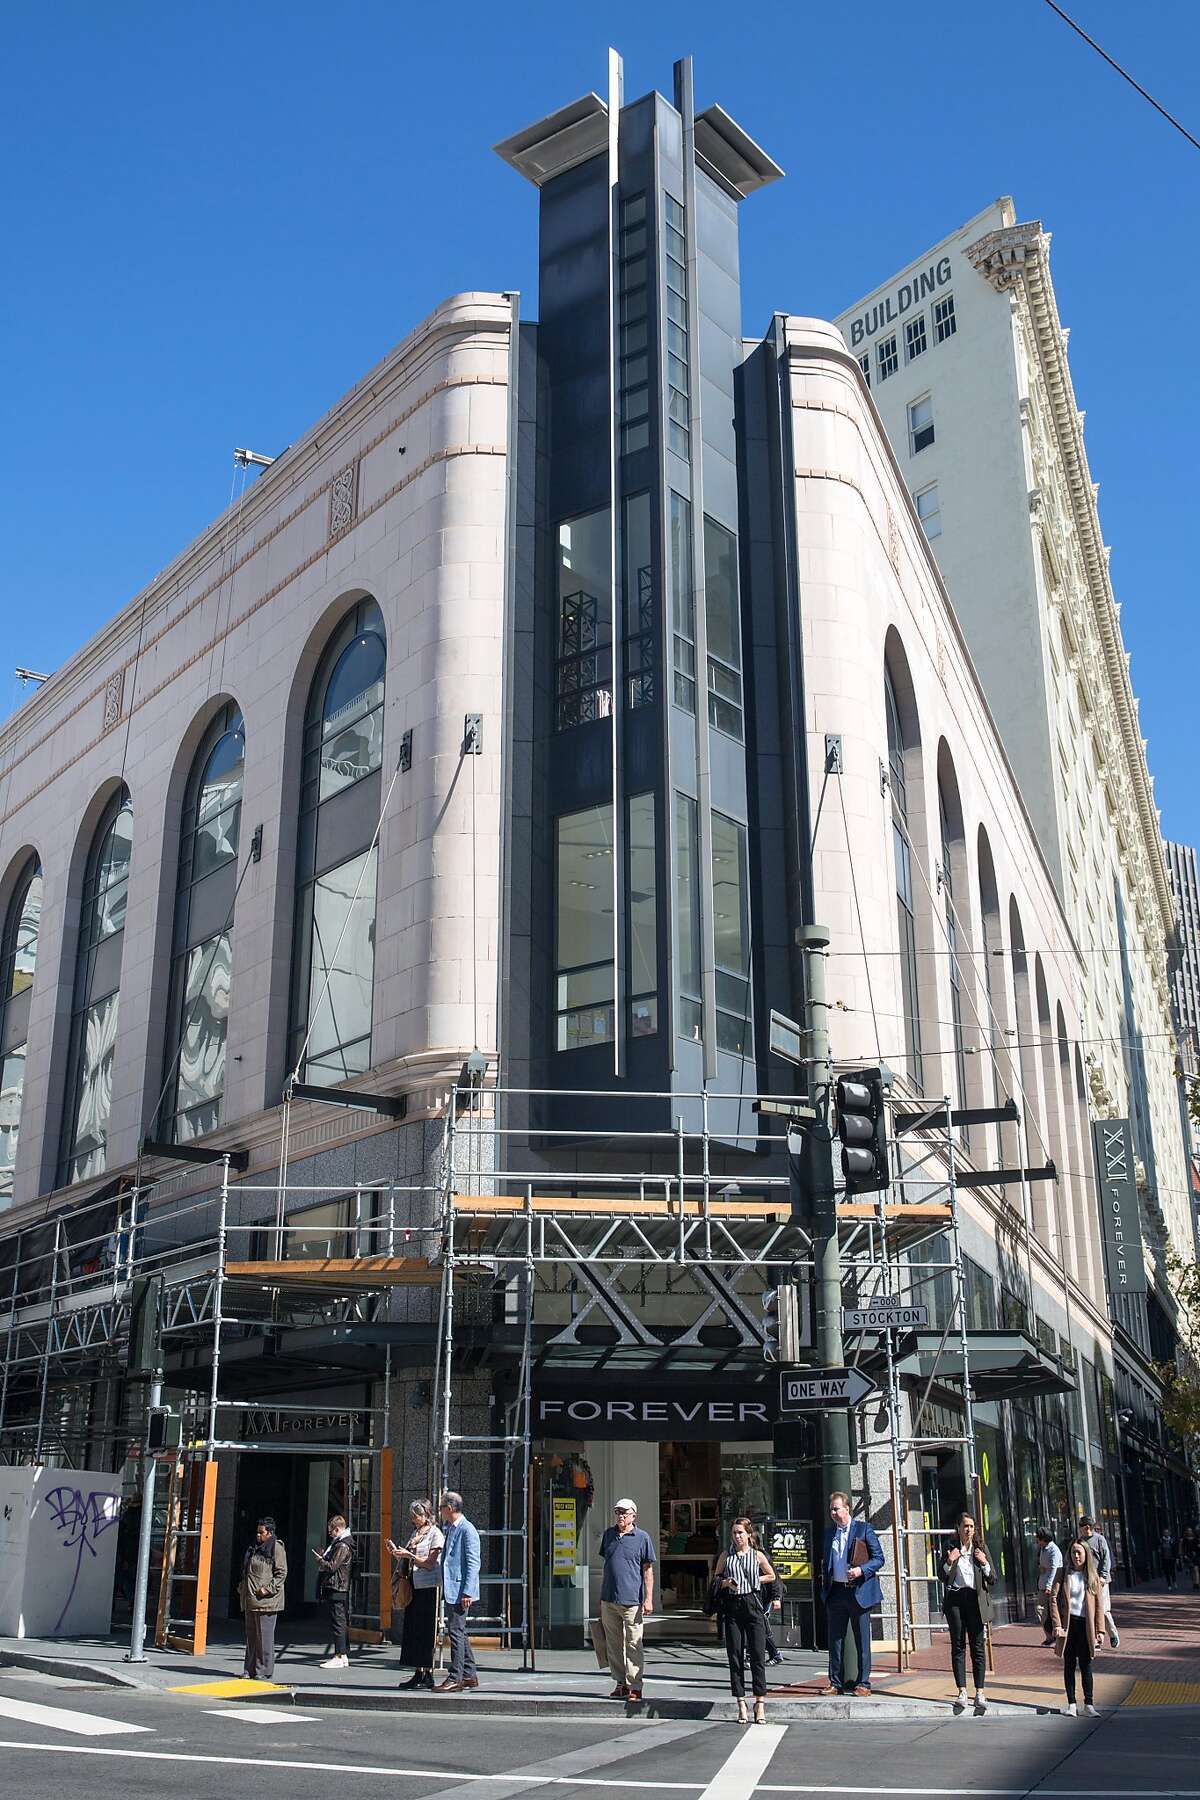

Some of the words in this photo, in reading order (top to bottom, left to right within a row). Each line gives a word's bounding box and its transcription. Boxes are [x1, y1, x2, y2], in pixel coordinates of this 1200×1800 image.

[850, 257, 952, 347] BUILDING
[1103, 1126, 1128, 1184] XXI
[1111, 1188, 1128, 1286] FOREVER
[852, 1310, 921, 1325] STOCKTON
[790, 1382, 816, 1398] ONE
[819, 1381, 847, 1397] WAY
[539, 1400, 769, 1422] FOREVER
[282, 1413, 360, 1433] FOREVER
[773, 1533, 805, 1550] 20%
